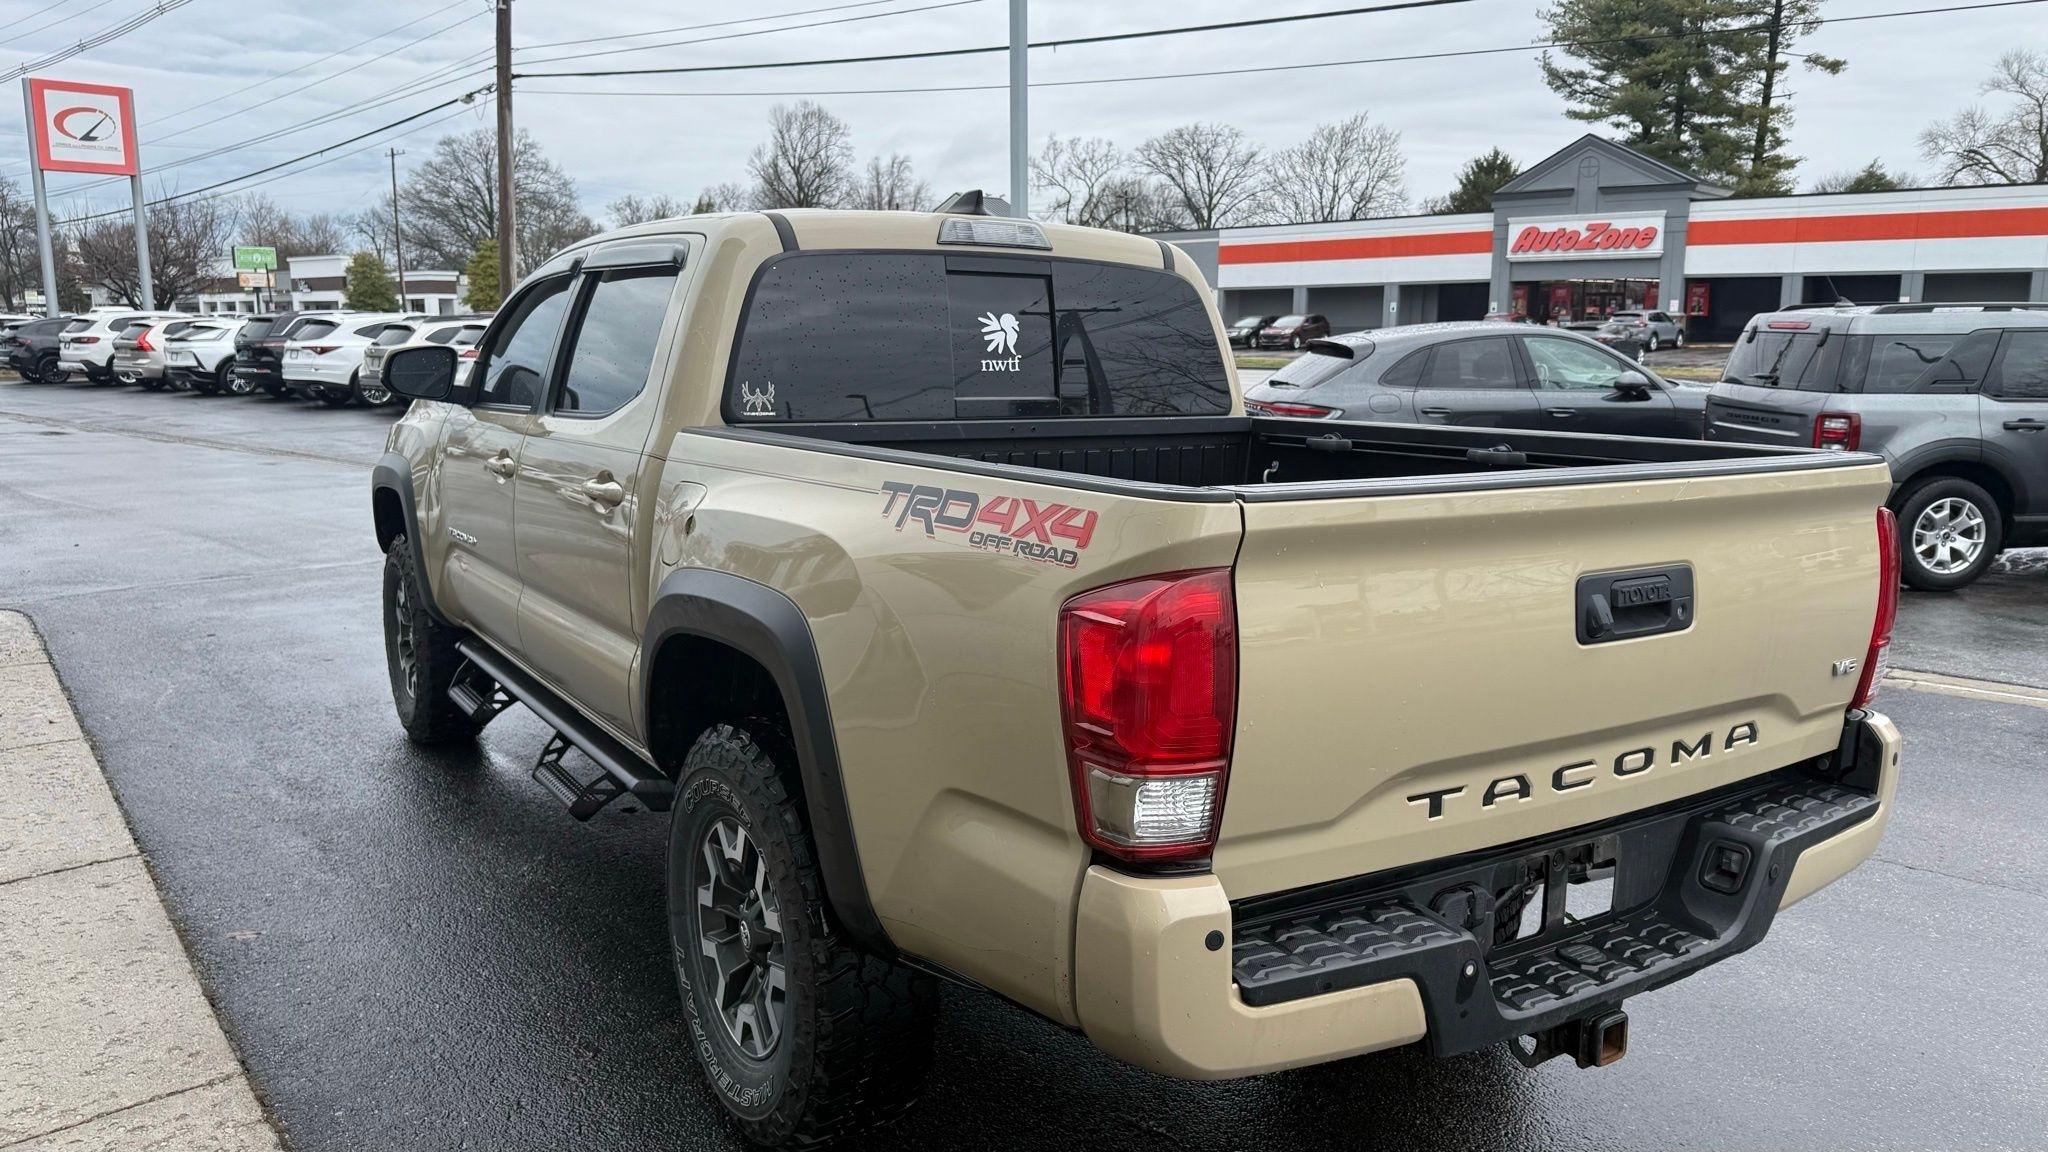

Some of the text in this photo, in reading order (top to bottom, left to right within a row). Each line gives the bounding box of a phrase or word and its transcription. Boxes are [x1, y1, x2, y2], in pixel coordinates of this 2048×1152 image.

[1510, 222, 1659, 254] AutoZone
[980, 354, 1022, 372] nwtf
[968, 531, 1080, 569] OFF ROAD
[1621, 582, 1671, 604] TOYOTA
[1405, 720, 1760, 821] TACOMA
